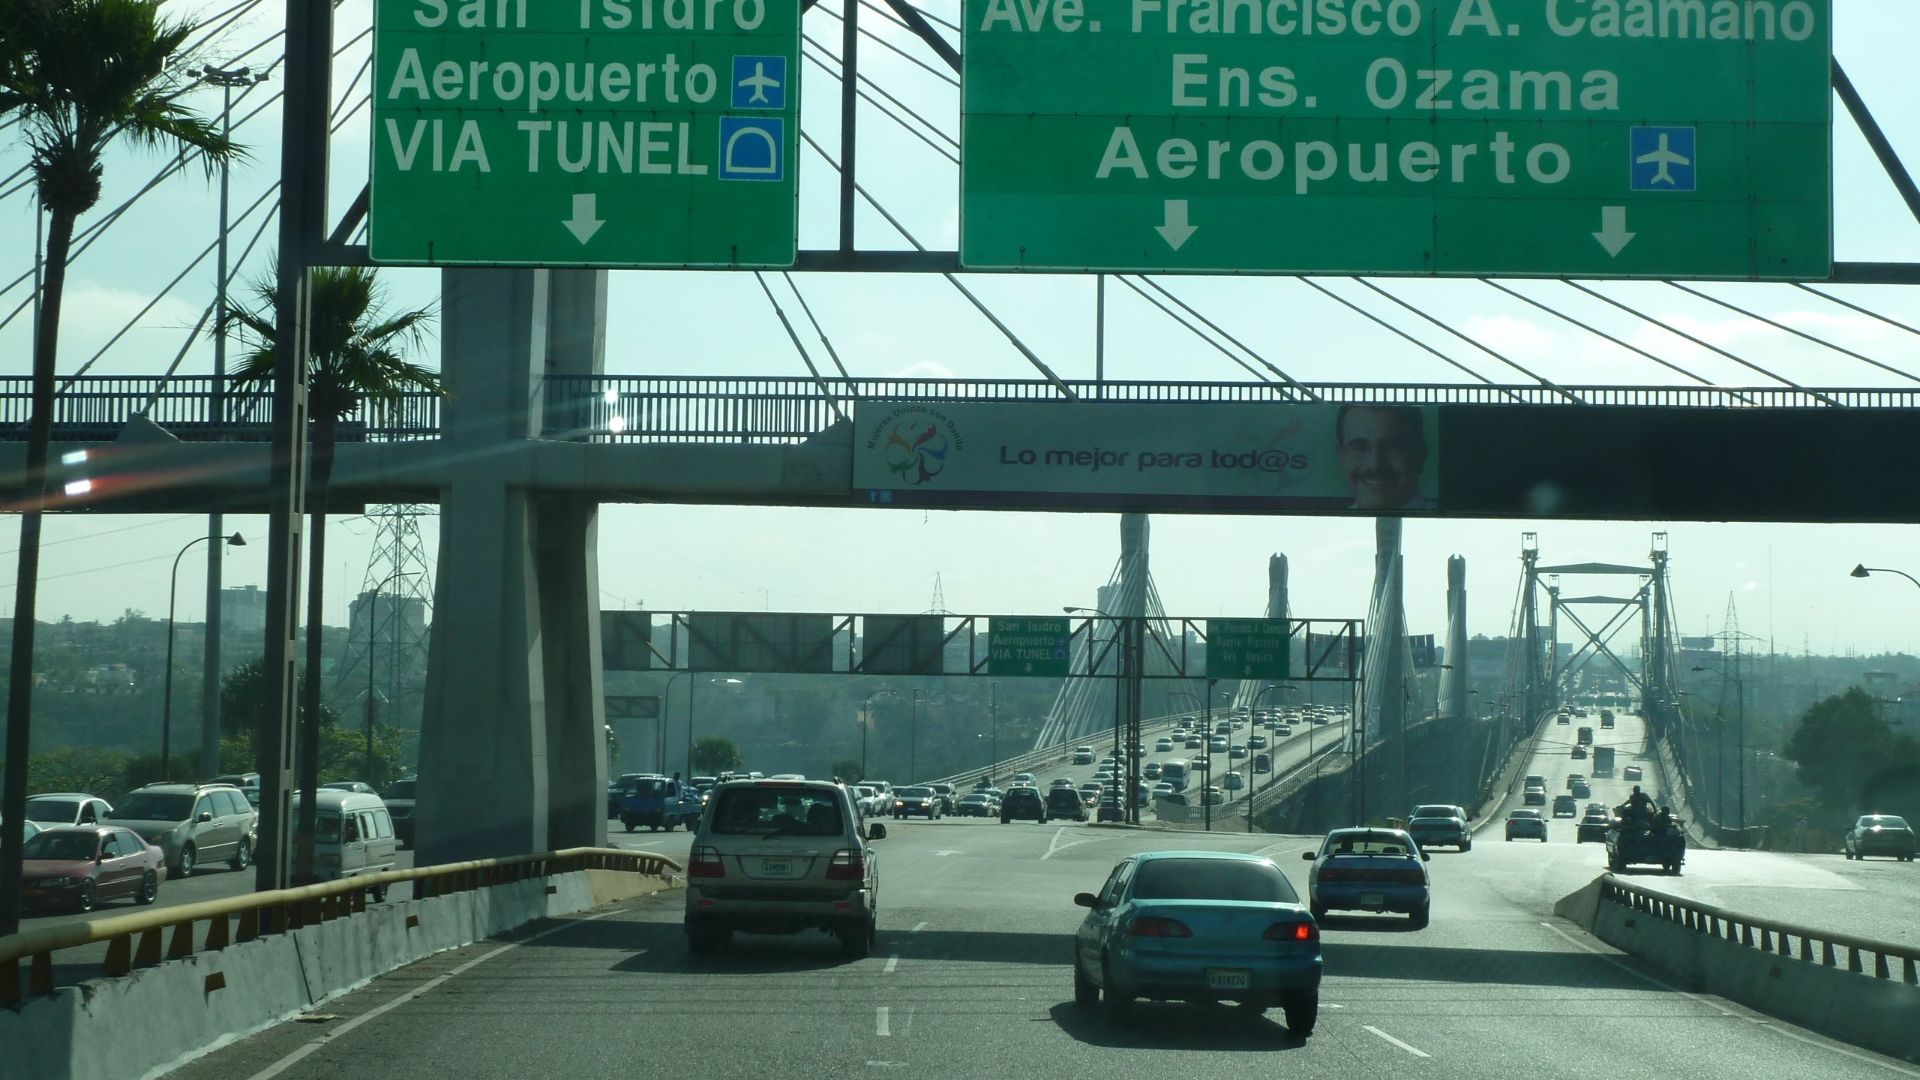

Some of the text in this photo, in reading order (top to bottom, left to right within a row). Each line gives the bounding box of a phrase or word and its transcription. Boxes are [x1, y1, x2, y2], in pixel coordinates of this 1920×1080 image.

[416, 0, 764, 29] San Isidro
[983, 0, 1099, 31] Ave.
[1133, 0, 1419, 35] Francisco
[1452, 0, 1518, 35] A.
[389, 48, 717, 113] Aeropuerto
[1173, 54, 1618, 110] Ens. Ozama
[386, 118, 708, 175] VIA TUNEL
[1097, 127, 1570, 194] Aeropuerto
[867, 405, 963, 451] Mujeres Unidas con Danilo
[999, 445, 1309, 473] Lo mejor para tod@s
[992, 634, 1054, 647] Aeropuerto
[998, 620, 1061, 632] San Isidro
[992, 648, 1053, 660] VIA TUNEL
